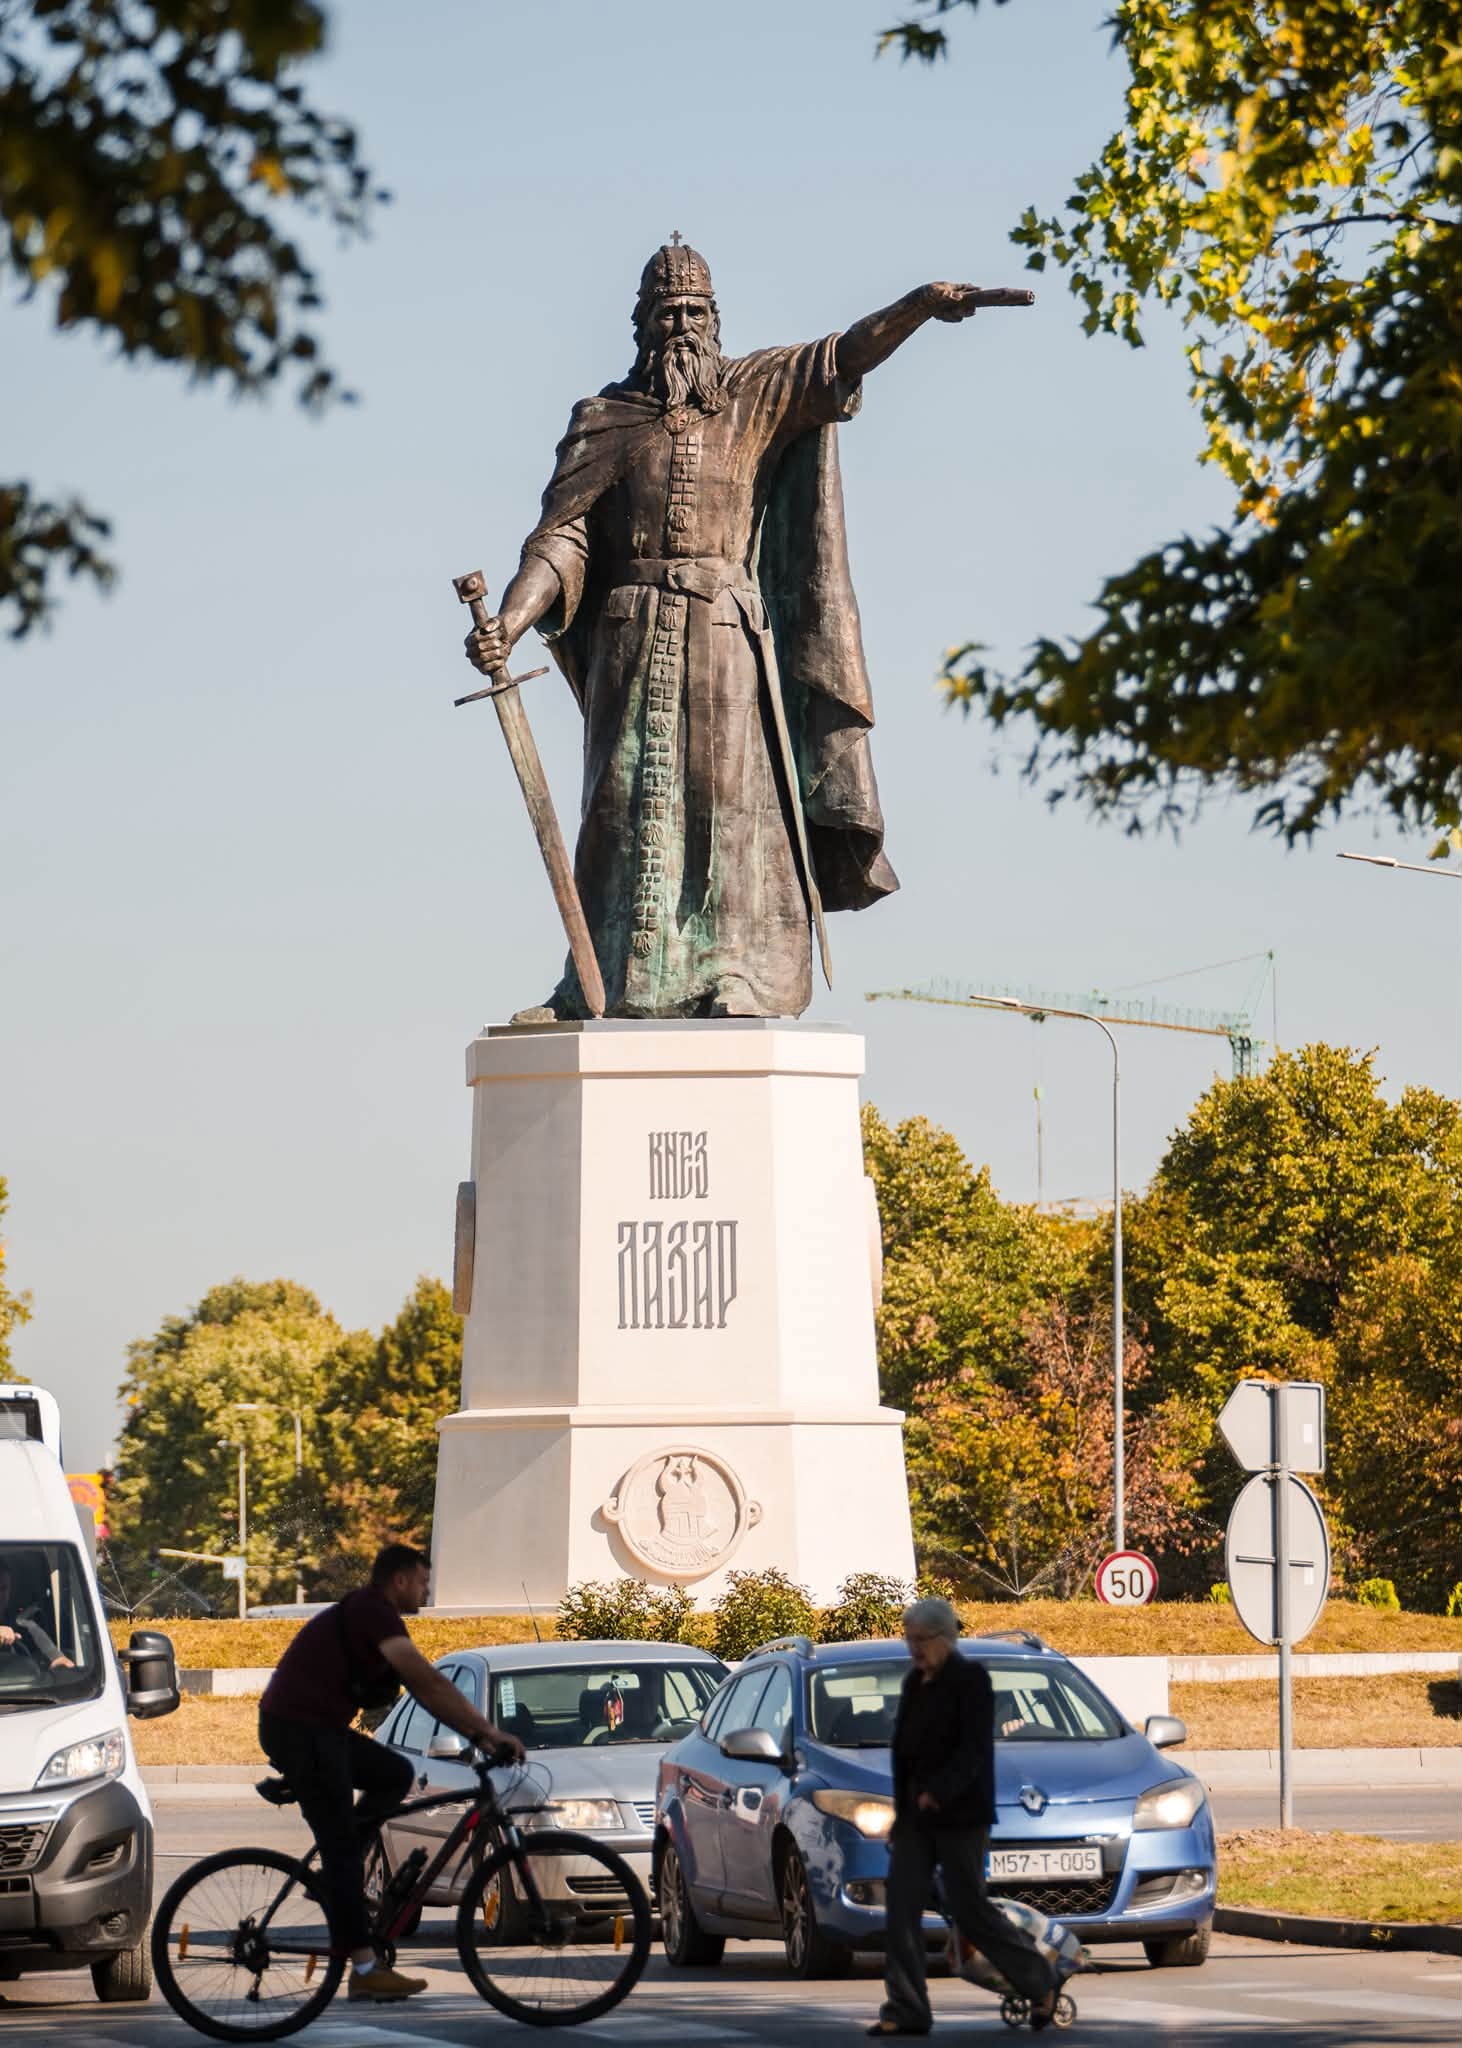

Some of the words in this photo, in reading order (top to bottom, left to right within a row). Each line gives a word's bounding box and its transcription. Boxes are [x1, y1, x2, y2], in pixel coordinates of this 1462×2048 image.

[617, 1220, 739, 1329] ЛАЗАР
[1111, 1569, 1144, 1598] 50
[993, 1853, 1097, 1873] M57-T-005
